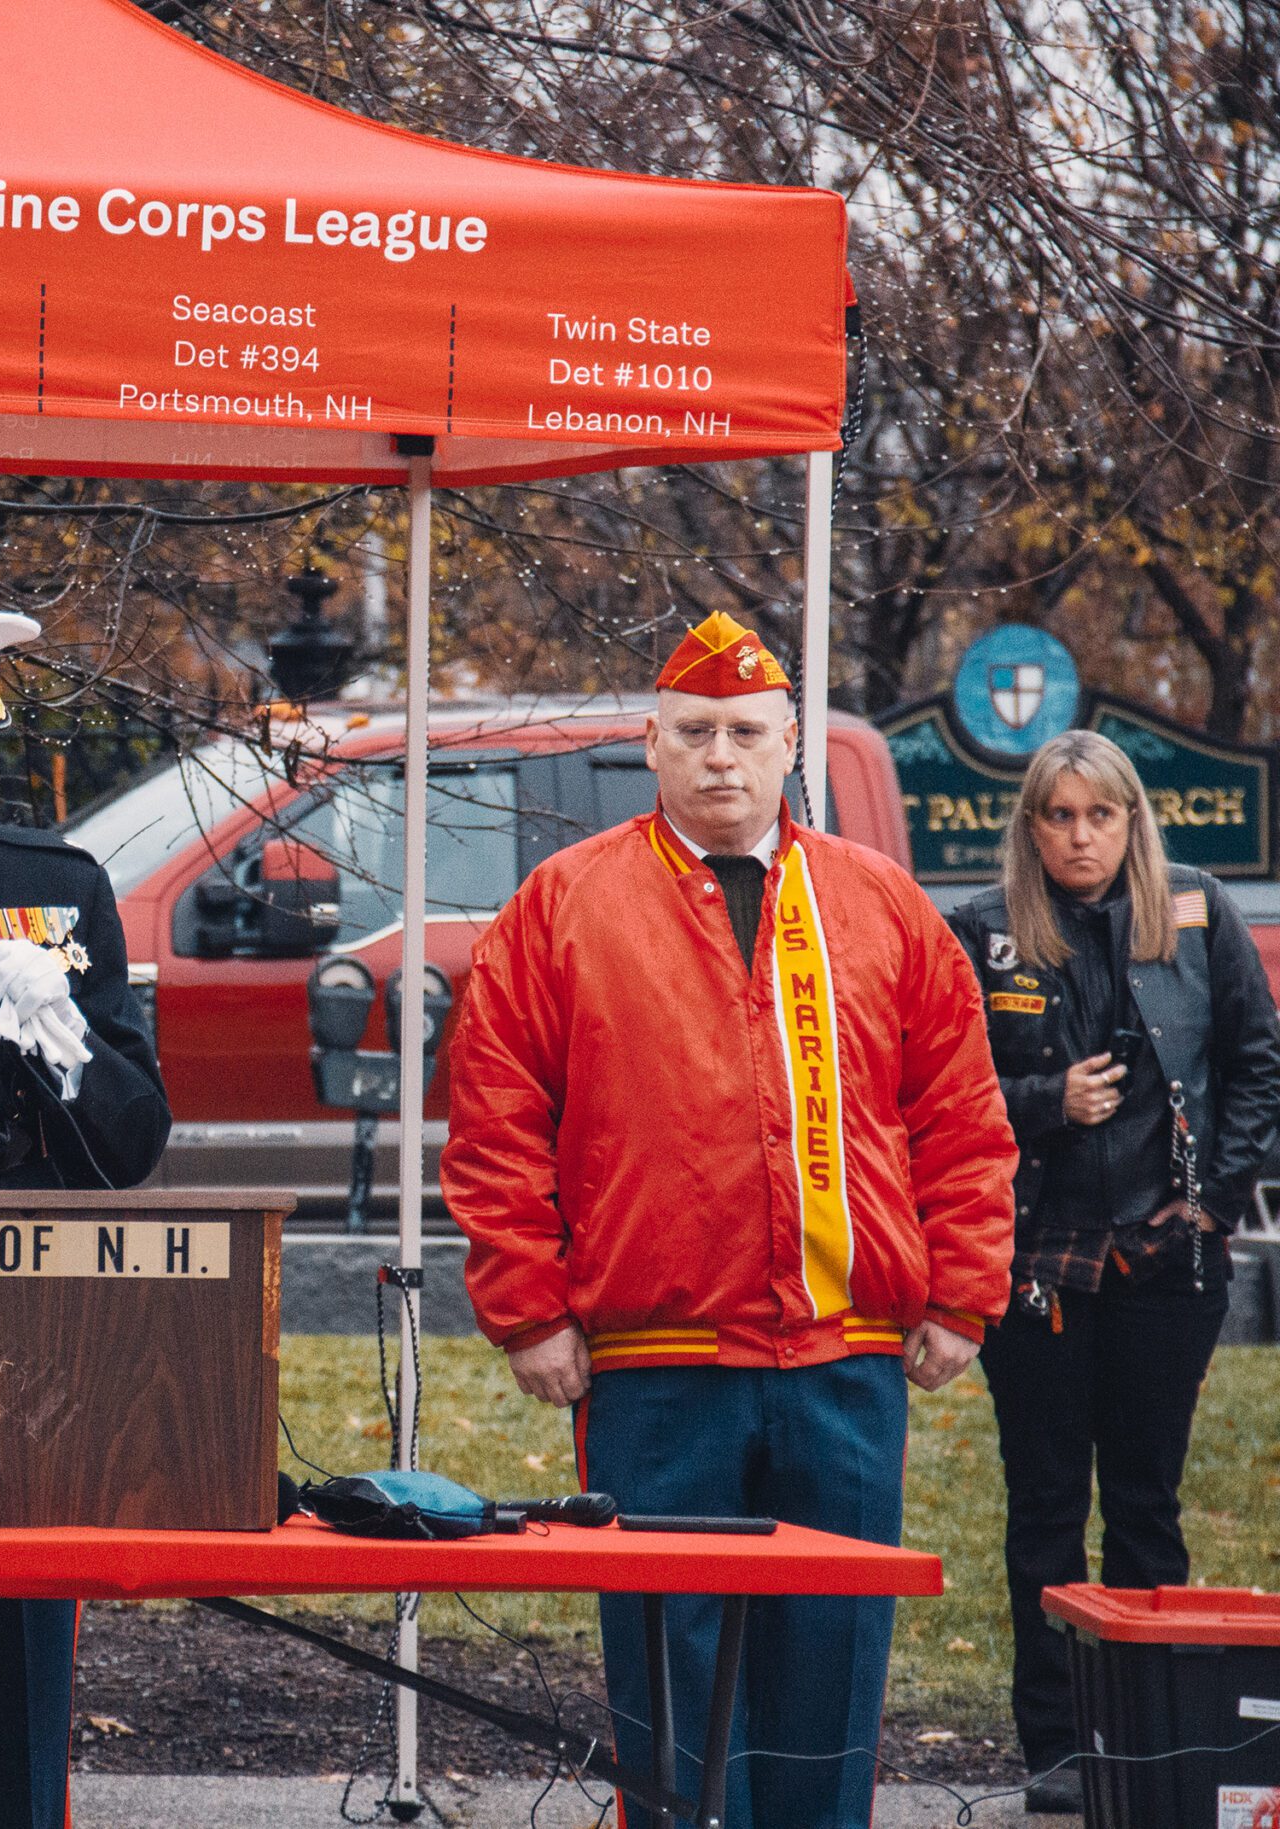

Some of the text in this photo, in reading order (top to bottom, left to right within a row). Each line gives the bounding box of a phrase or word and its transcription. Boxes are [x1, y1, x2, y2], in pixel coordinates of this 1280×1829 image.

[97, 188, 267, 253] Corps
[283, 195, 489, 264] League
[170, 293, 317, 329] Seacoast
[544, 311, 712, 348] Twin State
[173, 339, 321, 374] Det #394
[547, 357, 717, 394] Det #1010
[117, 382, 375, 423] Portsmouth, NH
[526, 403, 733, 440] Lebanon, NH
[927, 792, 1021, 832] PAU
[1146, 786, 1246, 827] RCH
[790, 972, 831, 1193] MARINES
